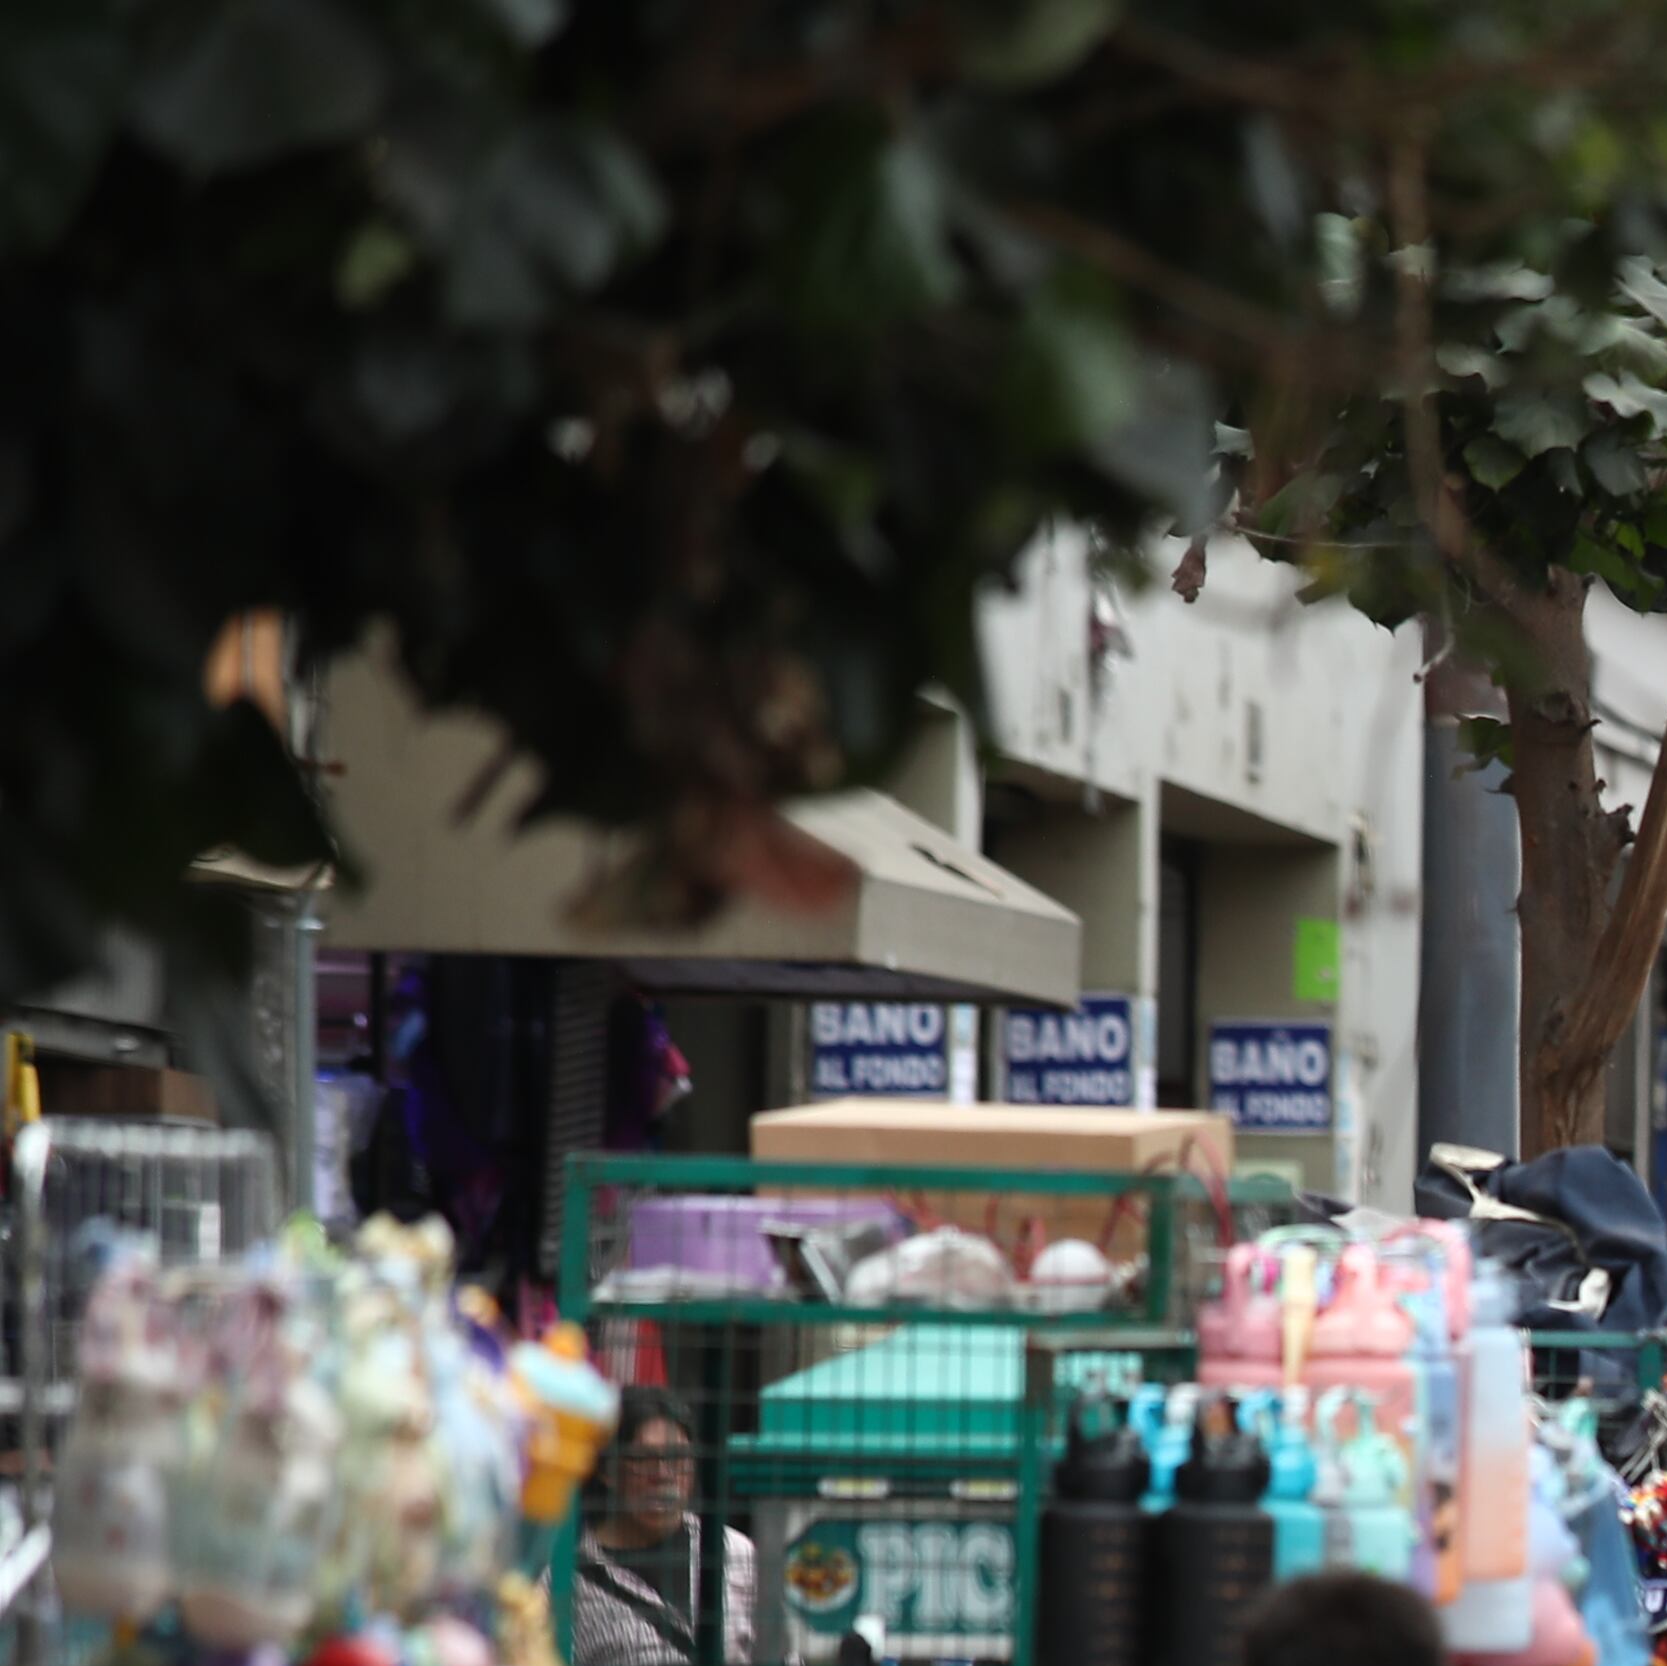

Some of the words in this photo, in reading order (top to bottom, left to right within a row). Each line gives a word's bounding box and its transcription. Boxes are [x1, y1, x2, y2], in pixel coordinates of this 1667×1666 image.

[815, 1055, 848, 1091] AL
[851, 1055, 943, 1091] FONDO
[1210, 1031, 1328, 1085] BAÑO
[1046, 1070, 1130, 1104] FONDO
[1245, 1092, 1330, 1124] FONDO
